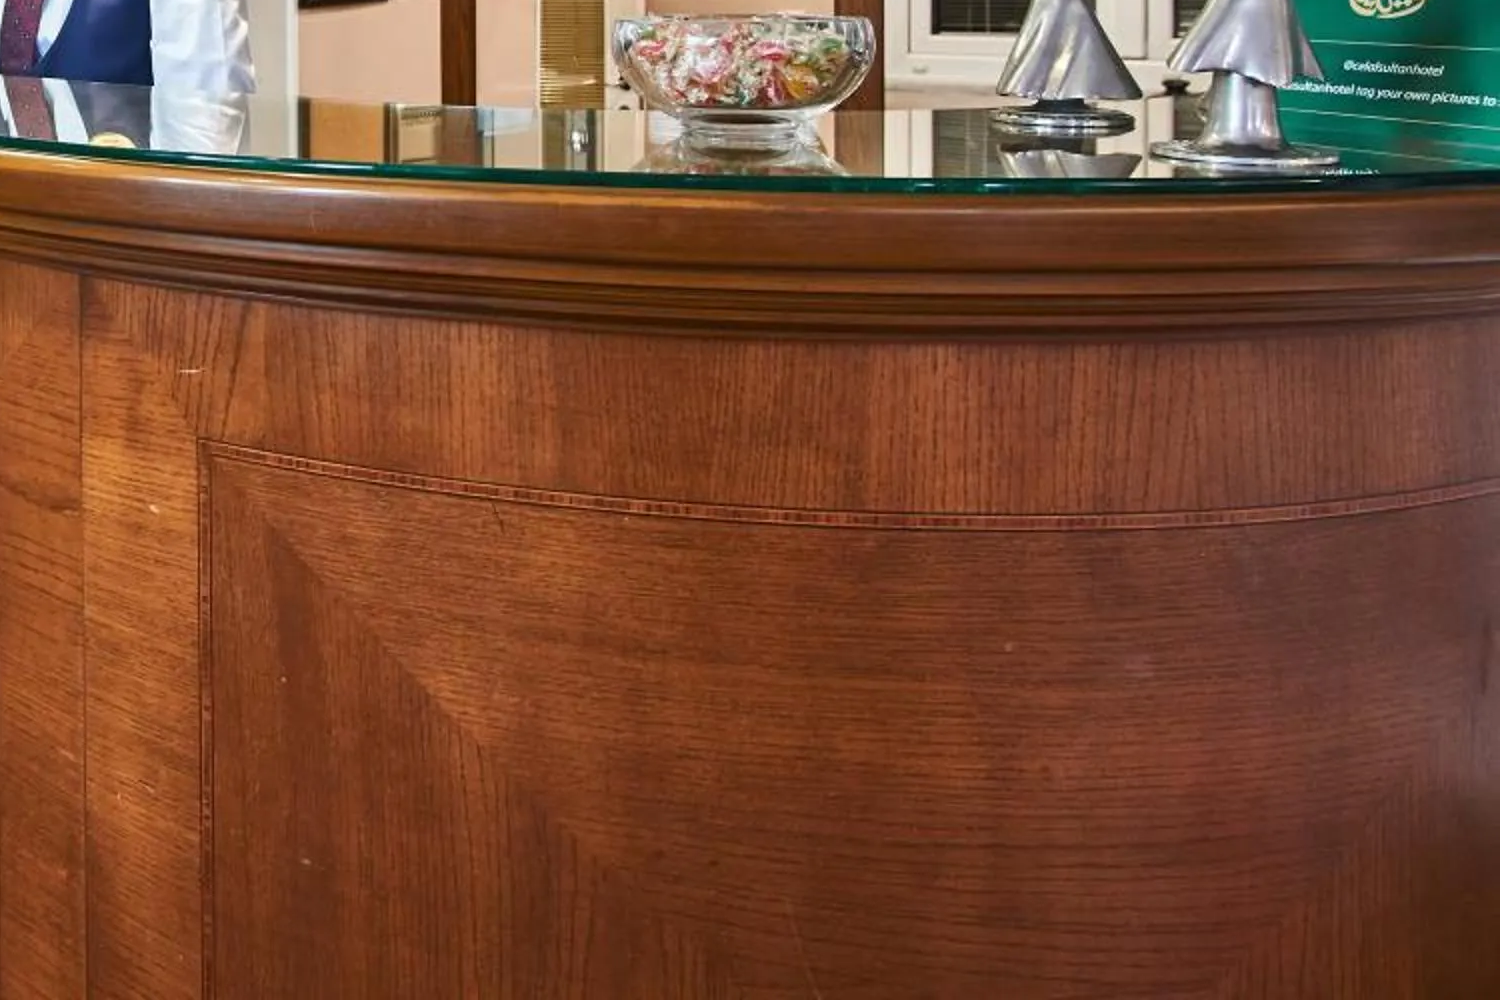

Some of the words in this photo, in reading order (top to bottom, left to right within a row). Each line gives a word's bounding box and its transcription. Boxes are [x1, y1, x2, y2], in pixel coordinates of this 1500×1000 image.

[1343, 60, 1445, 77] @celalsultanhotel
[1356, 85, 1375, 99] tag
[1376, 89, 1402, 100] your
[1404, 91, 1431, 101] own
[1431, 91, 1480, 105] pictures
[1483, 95, 1497, 107] to
